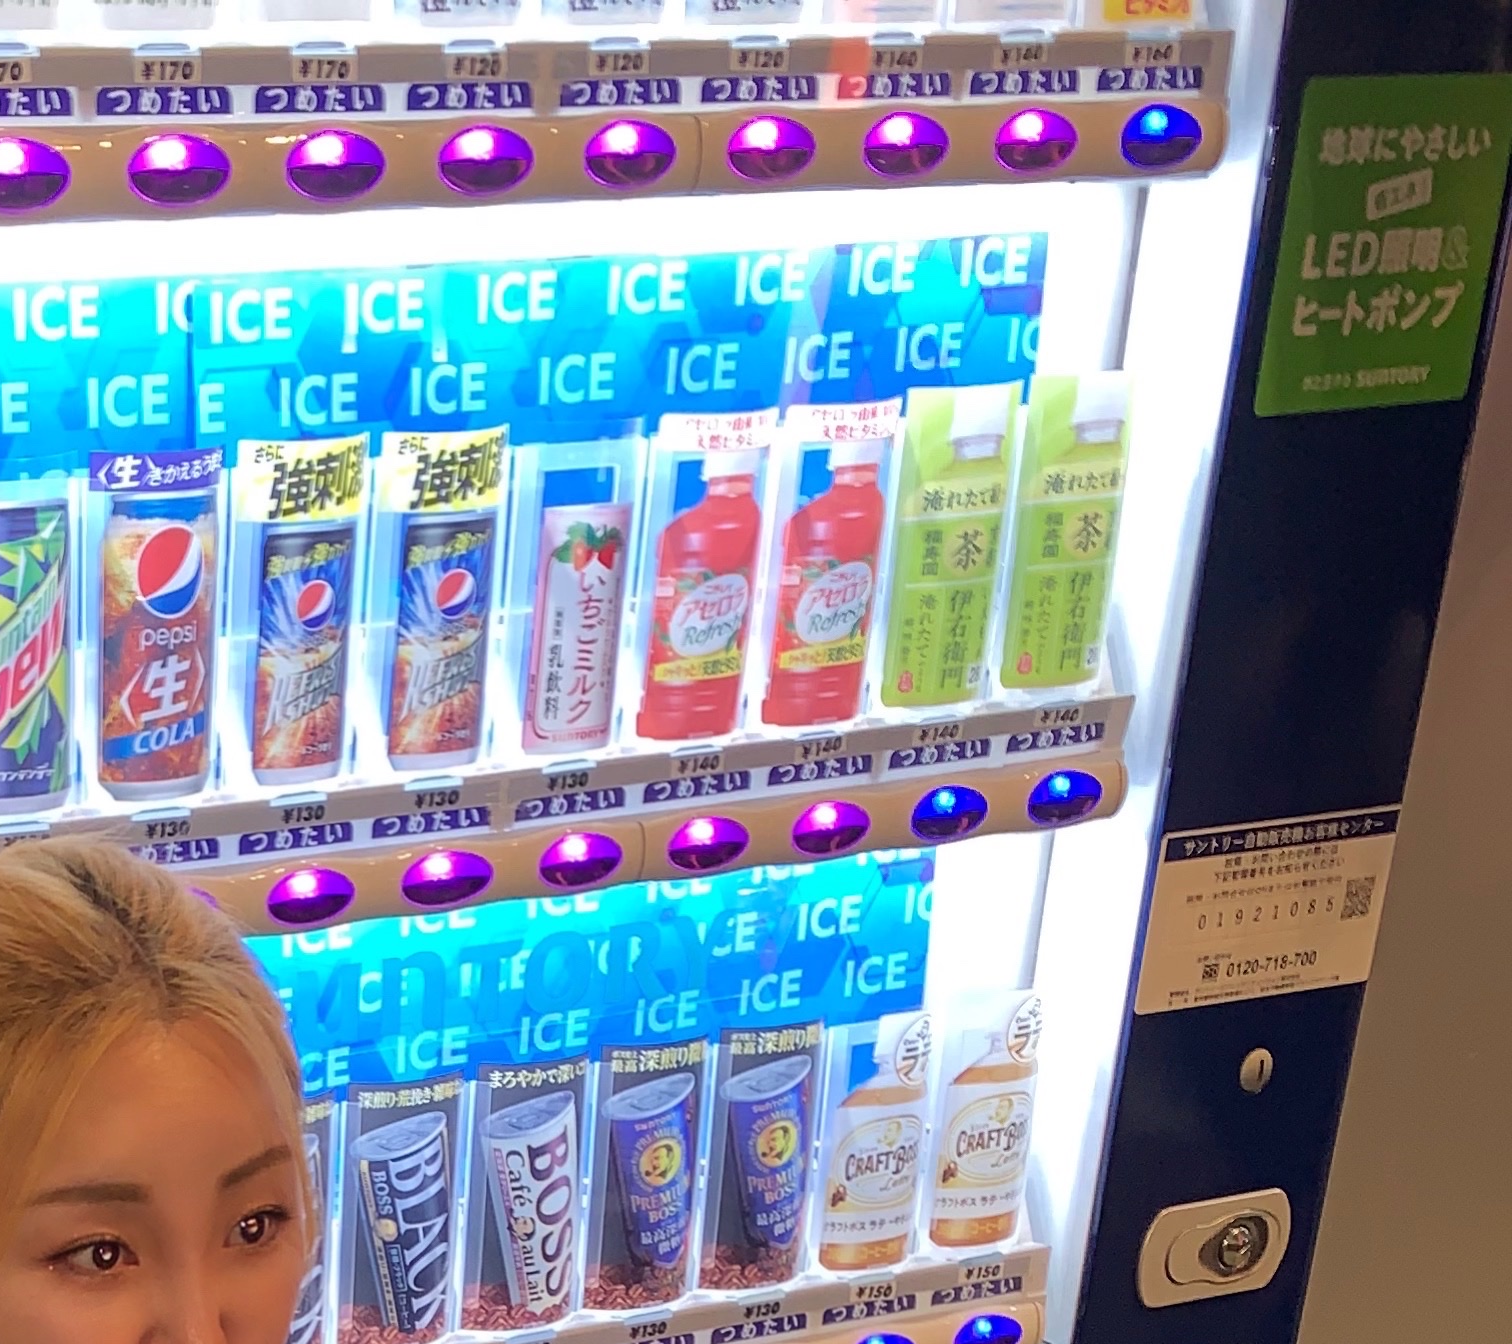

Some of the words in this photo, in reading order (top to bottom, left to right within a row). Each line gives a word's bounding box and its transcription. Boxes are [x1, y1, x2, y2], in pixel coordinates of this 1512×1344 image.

[141, 61, 194, 81] ¥170
[300, 60, 351, 79] ¥170
[712, 75, 810, 100] つめたい
[105, 87, 222, 113] つめたい
[264, 87, 376, 113] つめたい
[417, 83, 523, 108] つめたい
[571, 81, 672, 105] つめたい
[735, 254, 810, 306] ICE
[847, 241, 919, 297] ICE
[959, 235, 1032, 288] ICE
[344, 278, 425, 335] ICE
[477, 271, 556, 324] ICE
[607, 260, 688, 315] ICE
[1292, 280, 1465, 336] ヒートポンプ
[12, 285, 100, 342] ICE
[210, 287, 293, 344] ICE
[785, 331, 854, 384] ICE
[895, 322, 965, 372] ICE
[411, 361, 488, 417] ICE
[539, 352, 616, 406] ICE
[666, 342, 739, 395] ICE
[88, 373, 171, 430] ICE
[280, 372, 359, 428] ICE
[954, 529, 984, 571] 茶
[1075, 512, 1103, 553] 茶
[139, 620, 197, 652] pepsi
[566, 571, 607, 725] いちごミルク
[133, 717, 196, 755] COLA
[900, 738, 983, 766] つめたい
[1018, 723, 1097, 751] つめたい
[548, 772, 589, 790] ¥130
[653, 770, 742, 800] つめたい
[780, 756, 864, 782] つめたい
[282, 805, 325, 824] ¥130
[415, 789, 460, 808] ¥130
[525, 789, 616, 818] つめたい
[248, 824, 346, 853] つめたい
[384, 809, 480, 835] つめたい
[797, 894, 863, 941] ICE
[739, 969, 803, 1016] ICE
[844, 952, 909, 998] ICE
[519, 1008, 591, 1055] ICE
[634, 989, 699, 1036] ICE
[299, 1046, 350, 1092] CE
[396, 1026, 469, 1074] ICE
[956, 1127, 1004, 1158] CRAFT
[505, 1150, 533, 1208] Café
[845, 1149, 892, 1182] CRAFT
[372, 1170, 394, 1216] BOSS
[526, 1124, 573, 1297] BOSS
[856, 1282, 893, 1300] ¥150
[942, 1278, 1016, 1305] つめたい
[965, 1264, 1001, 1281] ¥150
[719, 1315, 800, 1344] つめたい
[744, 1302, 781, 1319] ¥130
[831, 1295, 909, 1324] つめたい
[630, 1321, 668, 1340] ¥130
